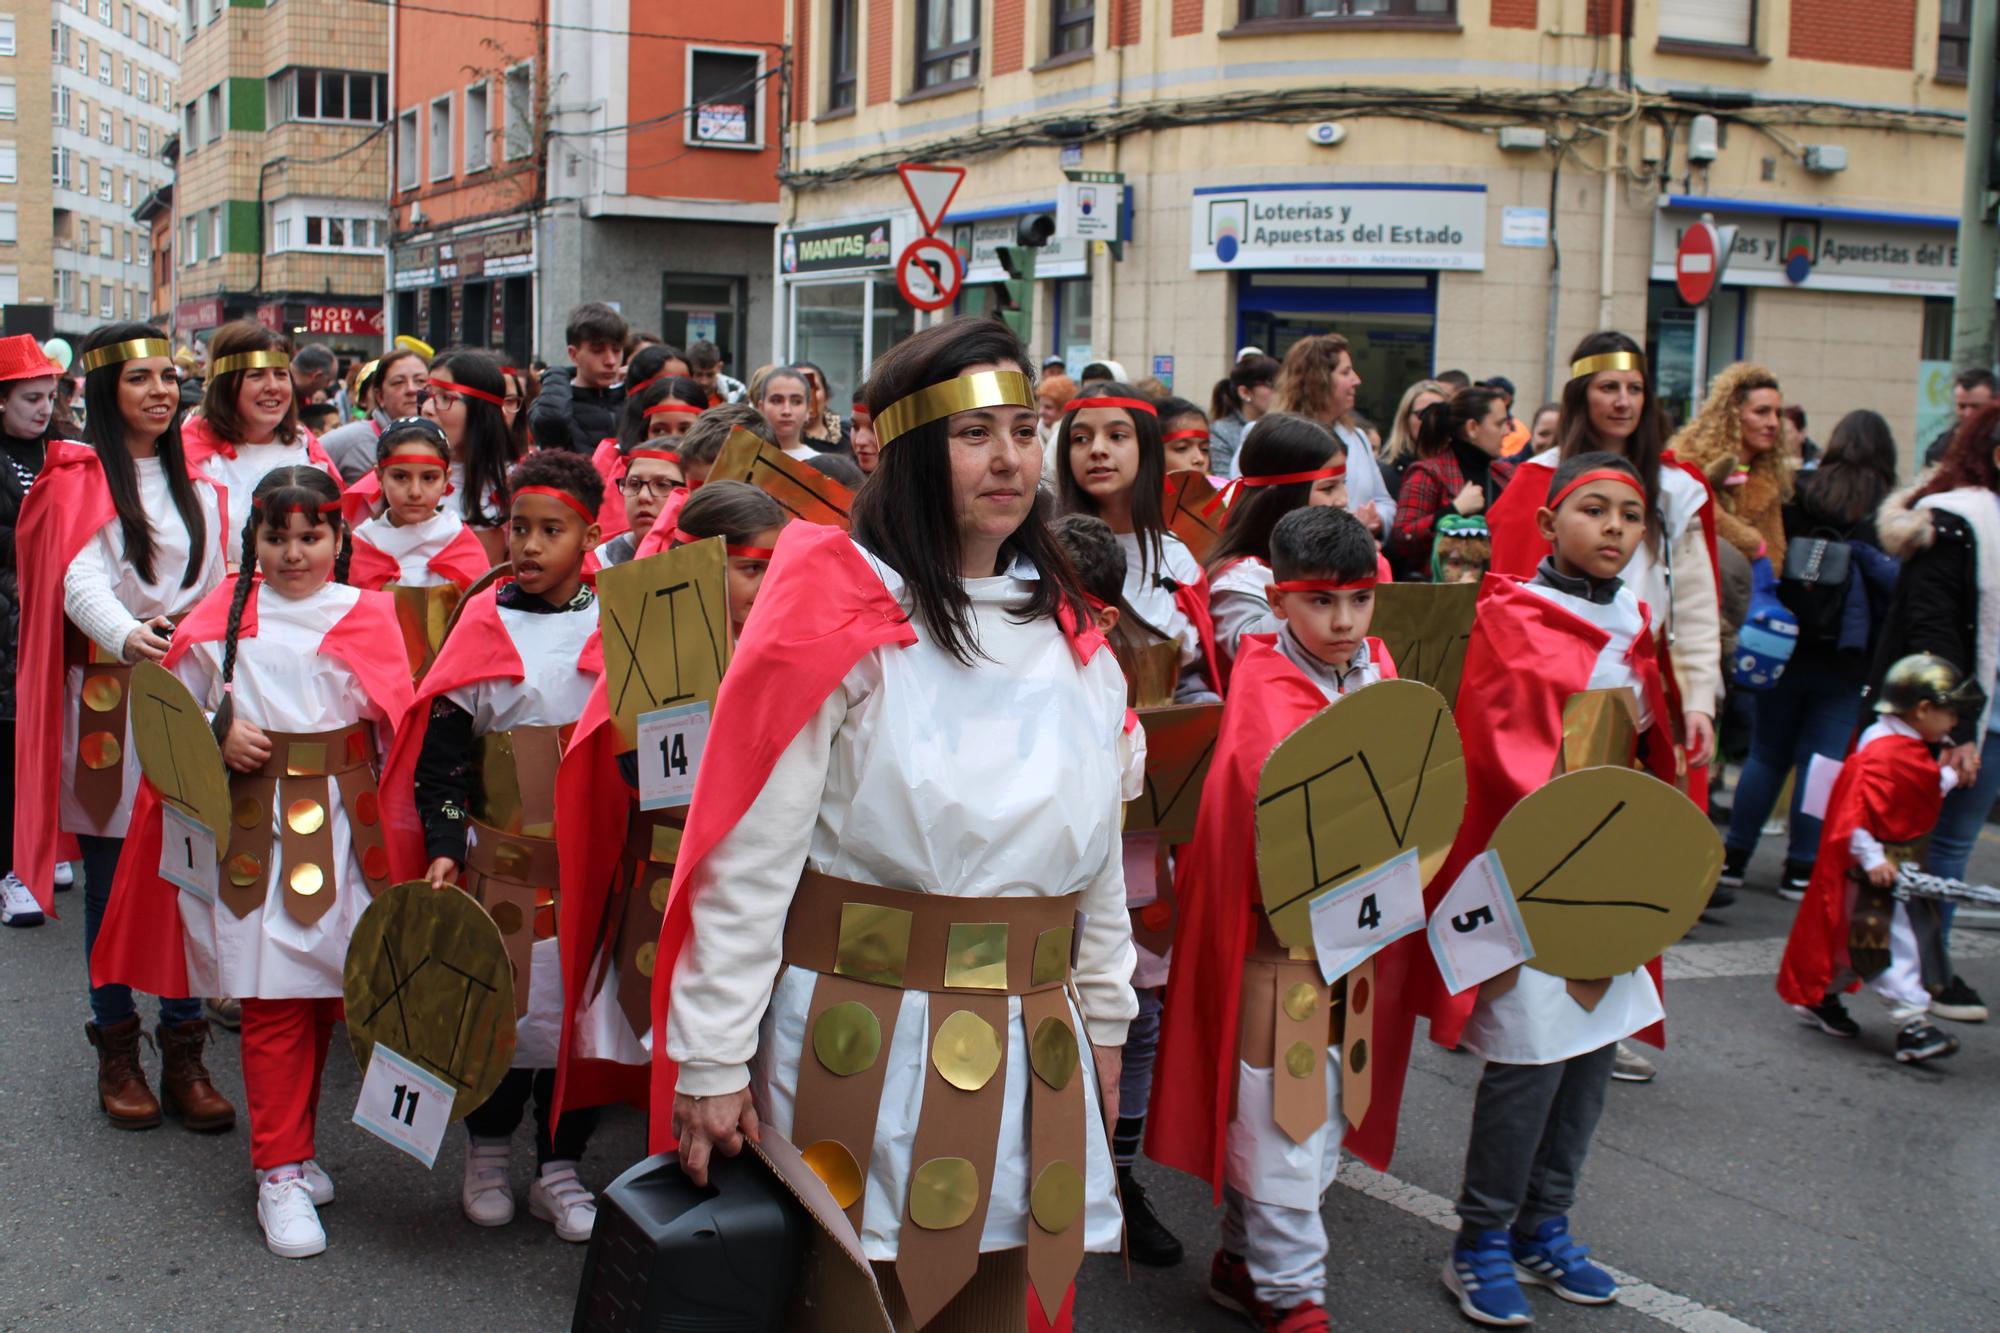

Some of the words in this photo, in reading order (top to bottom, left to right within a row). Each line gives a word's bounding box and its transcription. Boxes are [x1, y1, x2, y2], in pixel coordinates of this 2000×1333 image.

[1254, 201, 1333, 221] Loterías
[1341, 206, 1351, 224] y
[800, 234, 864, 260] MANITAS
[1254, 226, 1345, 247] Apuestas
[1352, 224, 1383, 244] del
[1391, 225, 1463, 244] Estado
[1764, 239, 1776, 261] y
[1822, 238, 1910, 264] Apuestas
[1916, 243, 1944, 266] del
[310, 307, 366, 322] MODA
[310, 319, 354, 334] PIEL
[659, 732, 689, 779] 14
[1258, 707, 1444, 916] IV
[184, 836, 194, 869] 1
[1357, 893, 1383, 930] 4
[1451, 905, 1495, 934] 5
[390, 1083, 421, 1127] 11
